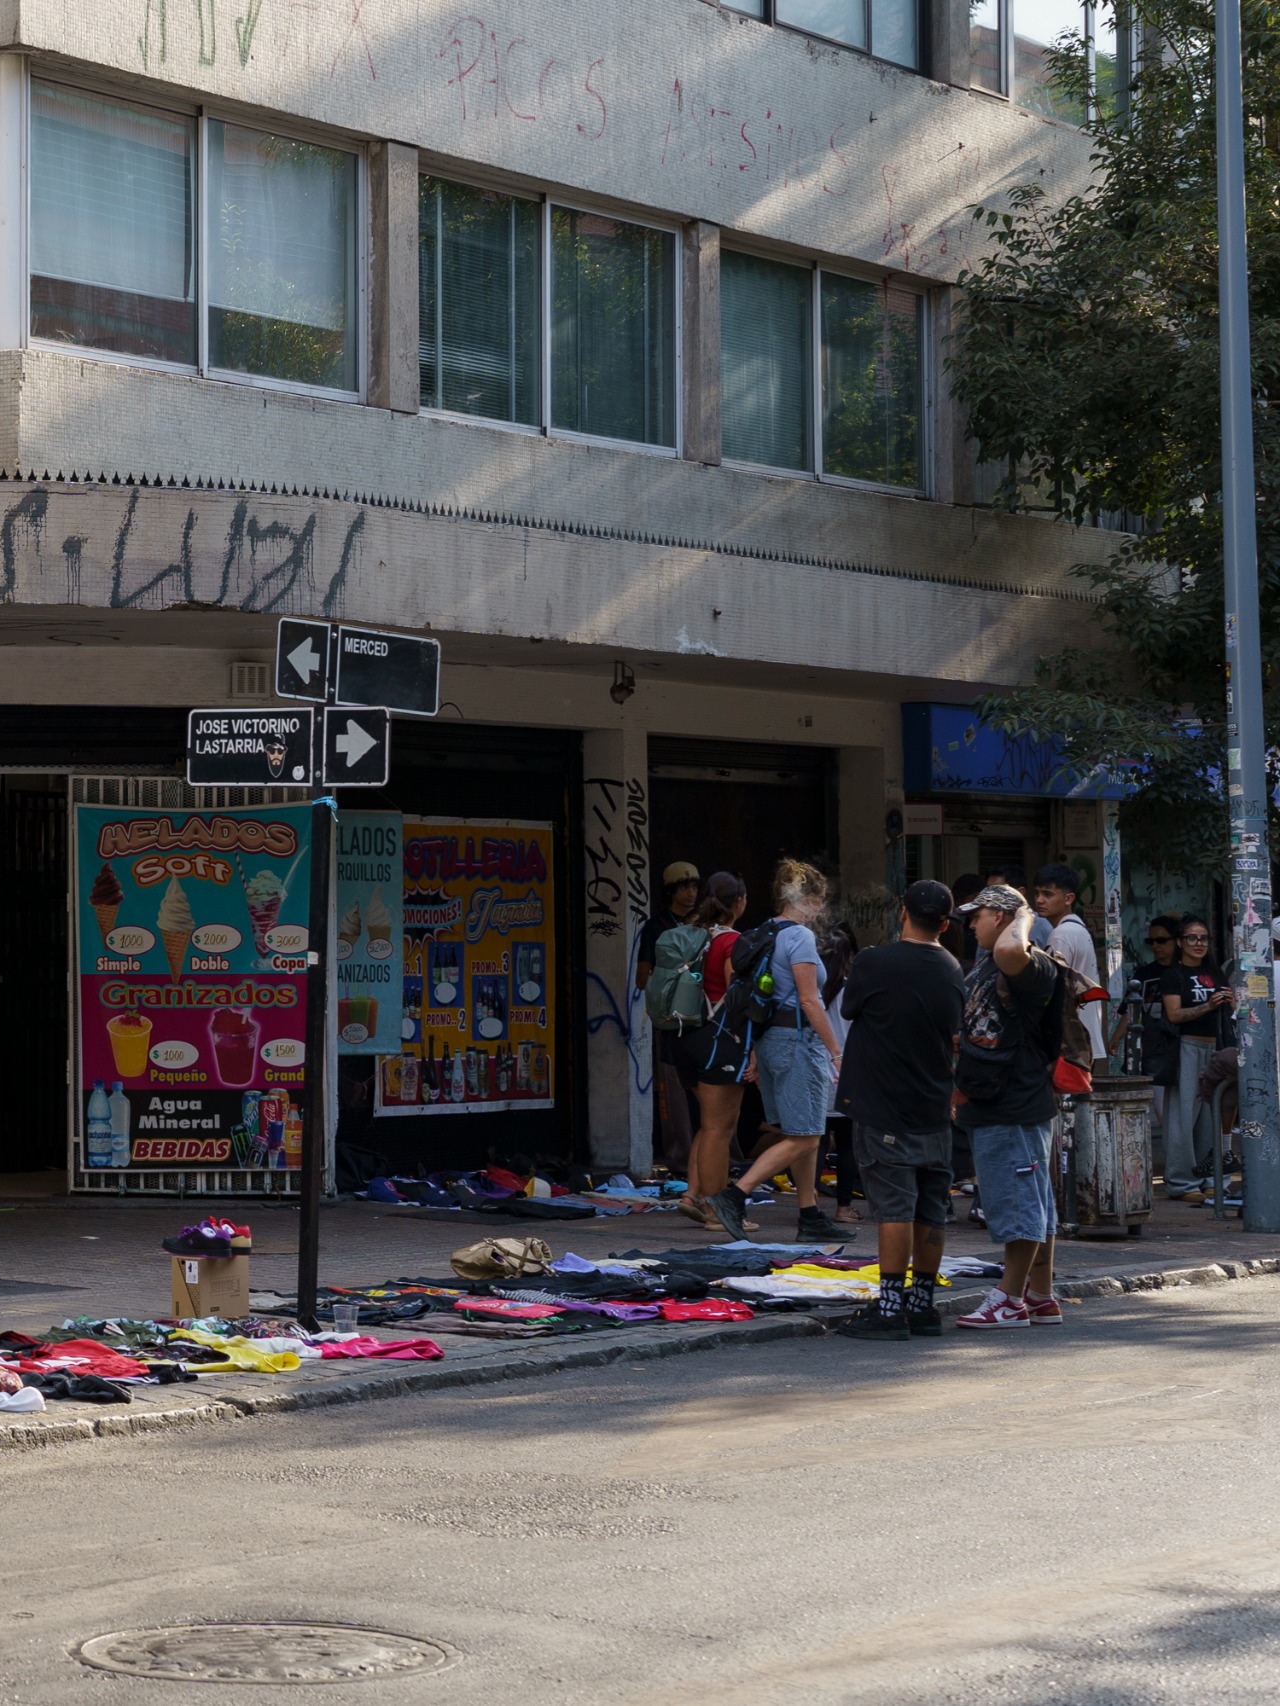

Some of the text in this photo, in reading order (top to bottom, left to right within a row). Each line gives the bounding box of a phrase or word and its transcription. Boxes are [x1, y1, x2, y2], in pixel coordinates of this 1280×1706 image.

[344, 637, 389, 657] MERCED
[195, 717, 300, 735] JOSE VICTORINO
[195, 738, 265, 754] LASTARRIA
[99, 816, 297, 857] HELADOS
[403, 838, 546, 882] OTILLERIA
[338, 861, 392, 883] RQUILLOS
[120, 933, 143, 948] 1000
[203, 932, 227, 945] 2000
[276, 934, 301, 947] 3000
[96, 956, 141, 973] Simple
[190, 956, 230, 971] Doble
[271, 955, 306, 974] Copa
[338, 964, 391, 983] ANIZADOS
[101, 980, 298, 1008] Granizados
[163, 1049, 184, 1061] 1000
[274, 1044, 296, 1057] 1500
[150, 1069, 208, 1086] Pequeño
[264, 1069, 305, 1082] Grand
[148, 1097, 202, 1113] Agua
[138, 1114, 221, 1129] Mineral
[132, 1139, 230, 1160] BEBIDAS
